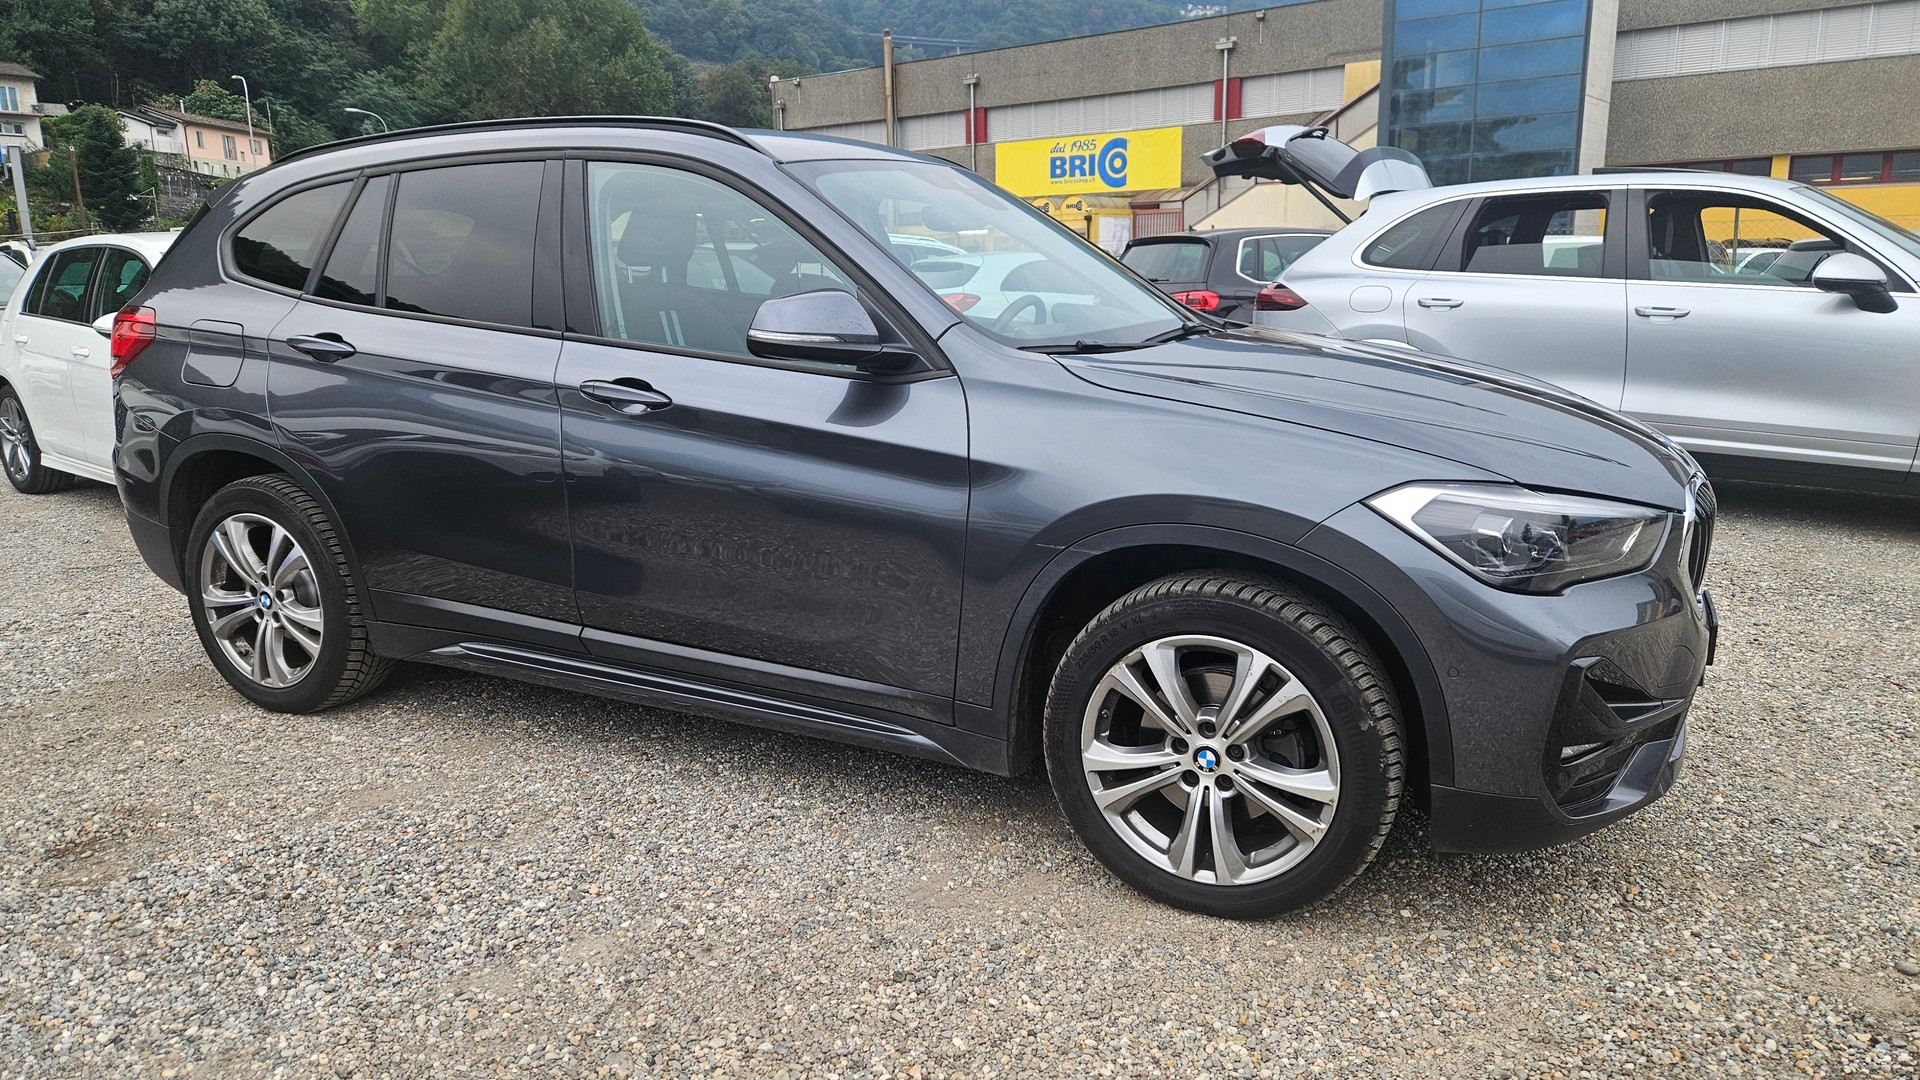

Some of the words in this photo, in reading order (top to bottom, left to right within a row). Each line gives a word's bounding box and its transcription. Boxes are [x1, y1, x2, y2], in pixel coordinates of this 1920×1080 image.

[1050, 142, 1067, 154] dal
[1070, 139, 1097, 152] 1985
[1050, 137, 1128, 188] BRICO
[1065, 200, 1083, 211] BRICO
[1076, 640, 1101, 670] 225/50
[1120, 621, 1128, 631] V
[1130, 614, 1145, 626] XL
